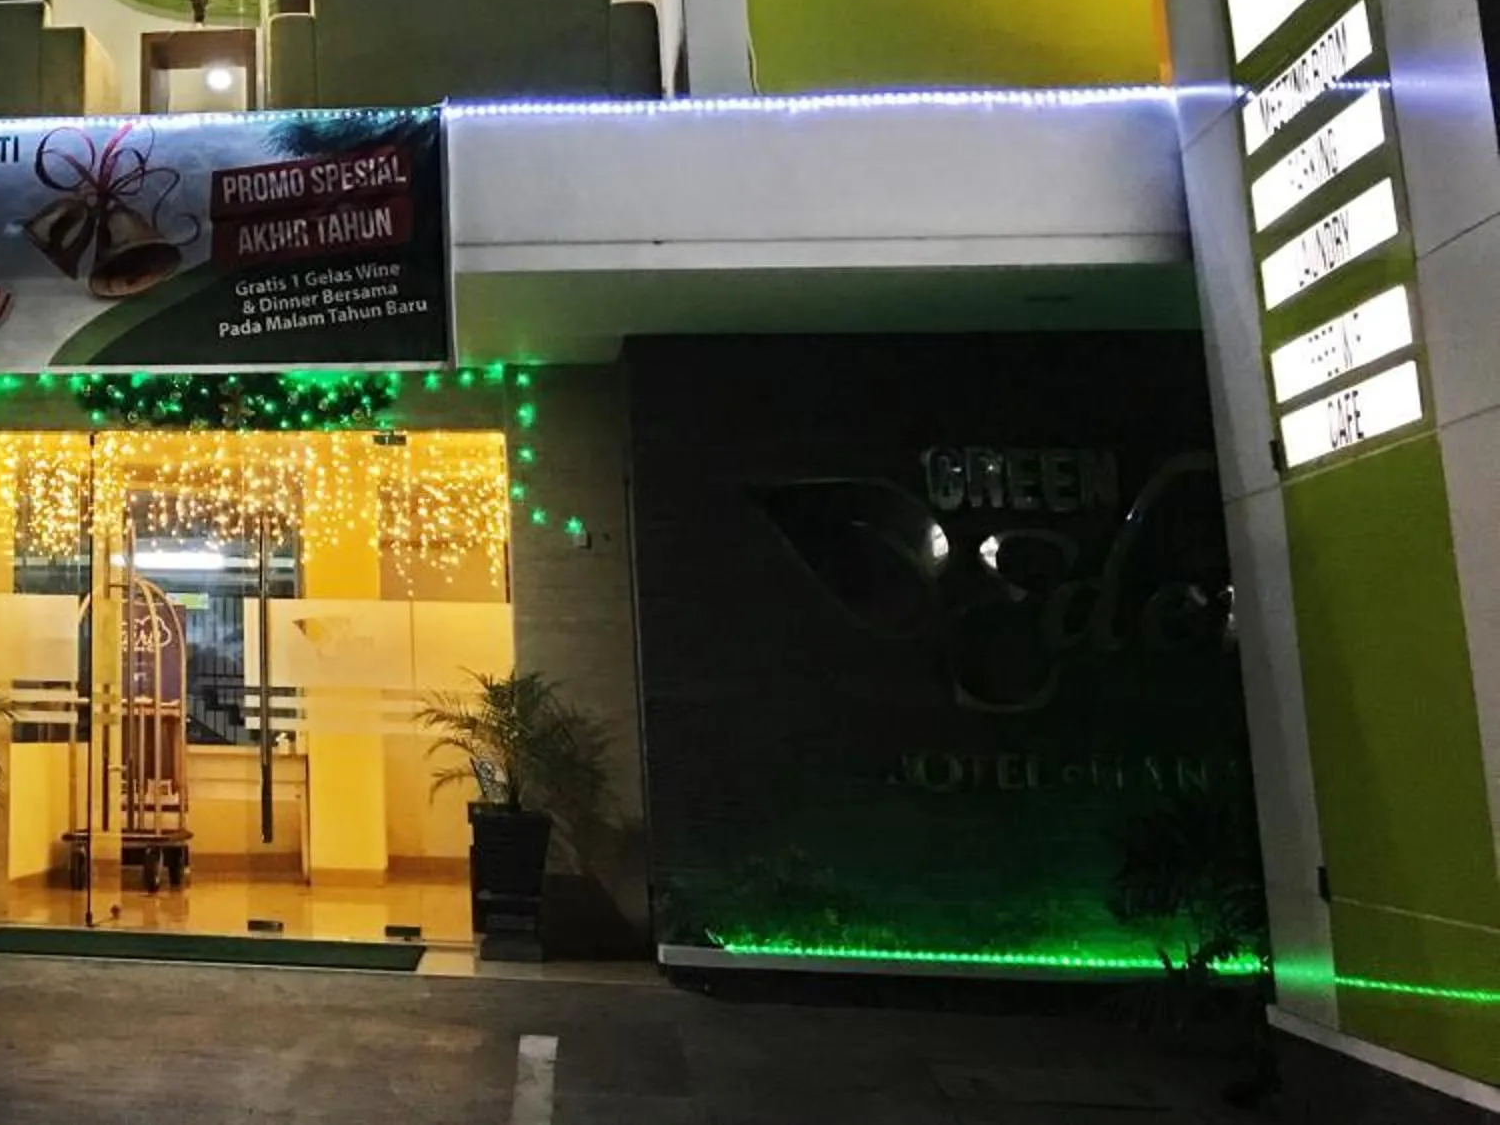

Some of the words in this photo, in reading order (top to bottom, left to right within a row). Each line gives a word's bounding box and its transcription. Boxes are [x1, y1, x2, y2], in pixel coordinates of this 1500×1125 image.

[221, 168, 306, 205] PROMO
[309, 154, 408, 193] SPESIAL
[237, 215, 310, 255] AKHIR
[315, 208, 393, 245] TAHUN
[235, 277, 288, 297] Gratis
[304, 268, 355, 289] Gelas
[355, 261, 401, 281] Wine
[242, 301, 256, 315] &
[259, 292, 320, 314] Dinner
[322, 284, 400, 305] Bersama
[218, 320, 262, 338] Pada
[264, 312, 324, 332] Malam
[325, 305, 384, 326] Tahun
[385, 297, 429, 318] Baru
[1327, 389, 1366, 450] CAFE
